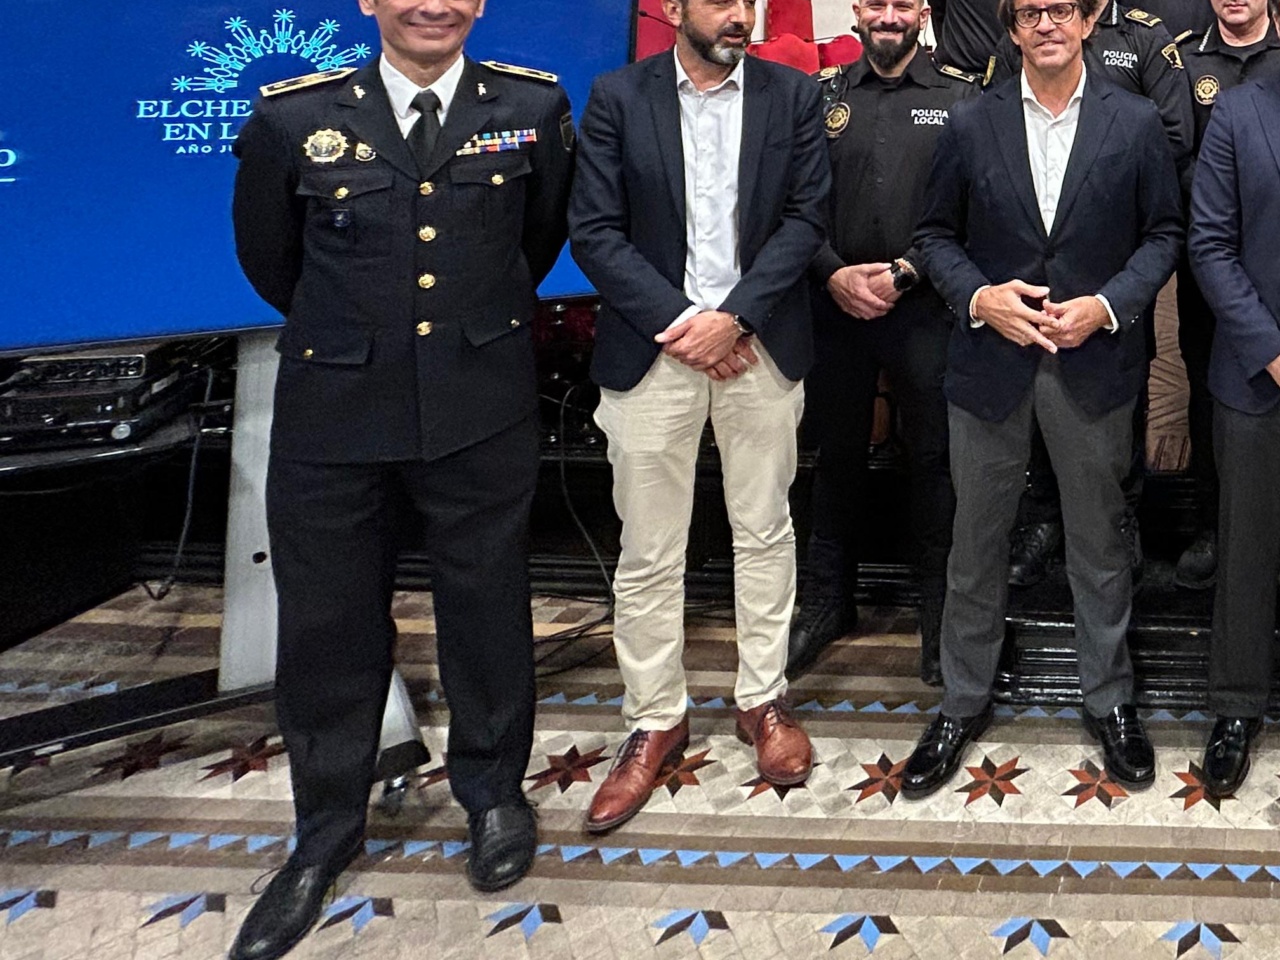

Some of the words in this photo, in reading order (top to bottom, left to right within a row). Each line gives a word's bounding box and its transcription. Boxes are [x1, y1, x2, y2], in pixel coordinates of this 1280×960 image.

[1102, 49, 1139, 63] POLICIA
[1104, 57, 1134, 69] LOCAL
[136, 99, 254, 118] ELCHE
[910, 108, 949, 119] POLICIA
[913, 116, 945, 126] LOCAL
[162, 122, 213, 141] EN
[218, 122, 240, 140] L
[175, 144, 213, 154] AÑO
